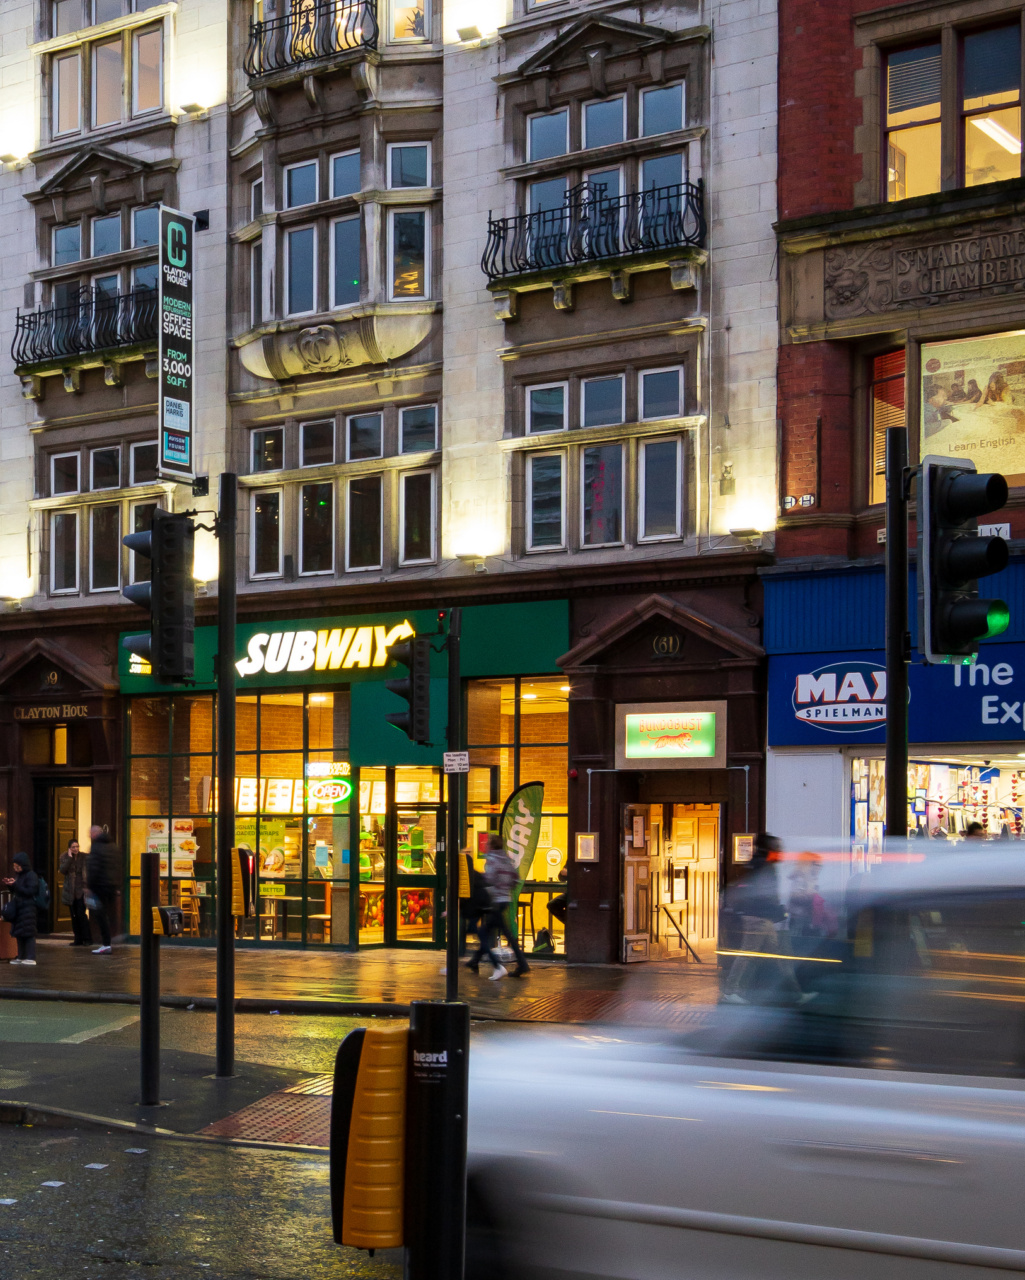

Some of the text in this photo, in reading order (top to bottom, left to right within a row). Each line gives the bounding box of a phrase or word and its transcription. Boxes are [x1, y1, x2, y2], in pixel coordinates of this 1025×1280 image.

[163, 264, 191, 281] CLAYTON
[166, 273, 188, 288] HOUSE
[163, 295, 191, 312] MODERN
[163, 312, 191, 329] OFFICE
[163, 323, 191, 340] SPACE
[167, 348, 187, 362] FROM
[163, 358, 192, 378] 3,000
[165, 400, 184, 411] DANIEL
[948, 436, 1016, 452] Learn English
[235, 619, 416, 677] SUBWAY
[13, 704, 88, 719] CLAYTON HOUS
[805, 706, 884, 719] SPIELMAN
[981, 695, 1025, 732] Ex
[639, 718, 703, 733] BUNDOBUST
[314, 785, 346, 798] OPEN
[413, 1049, 448, 1063] heard
